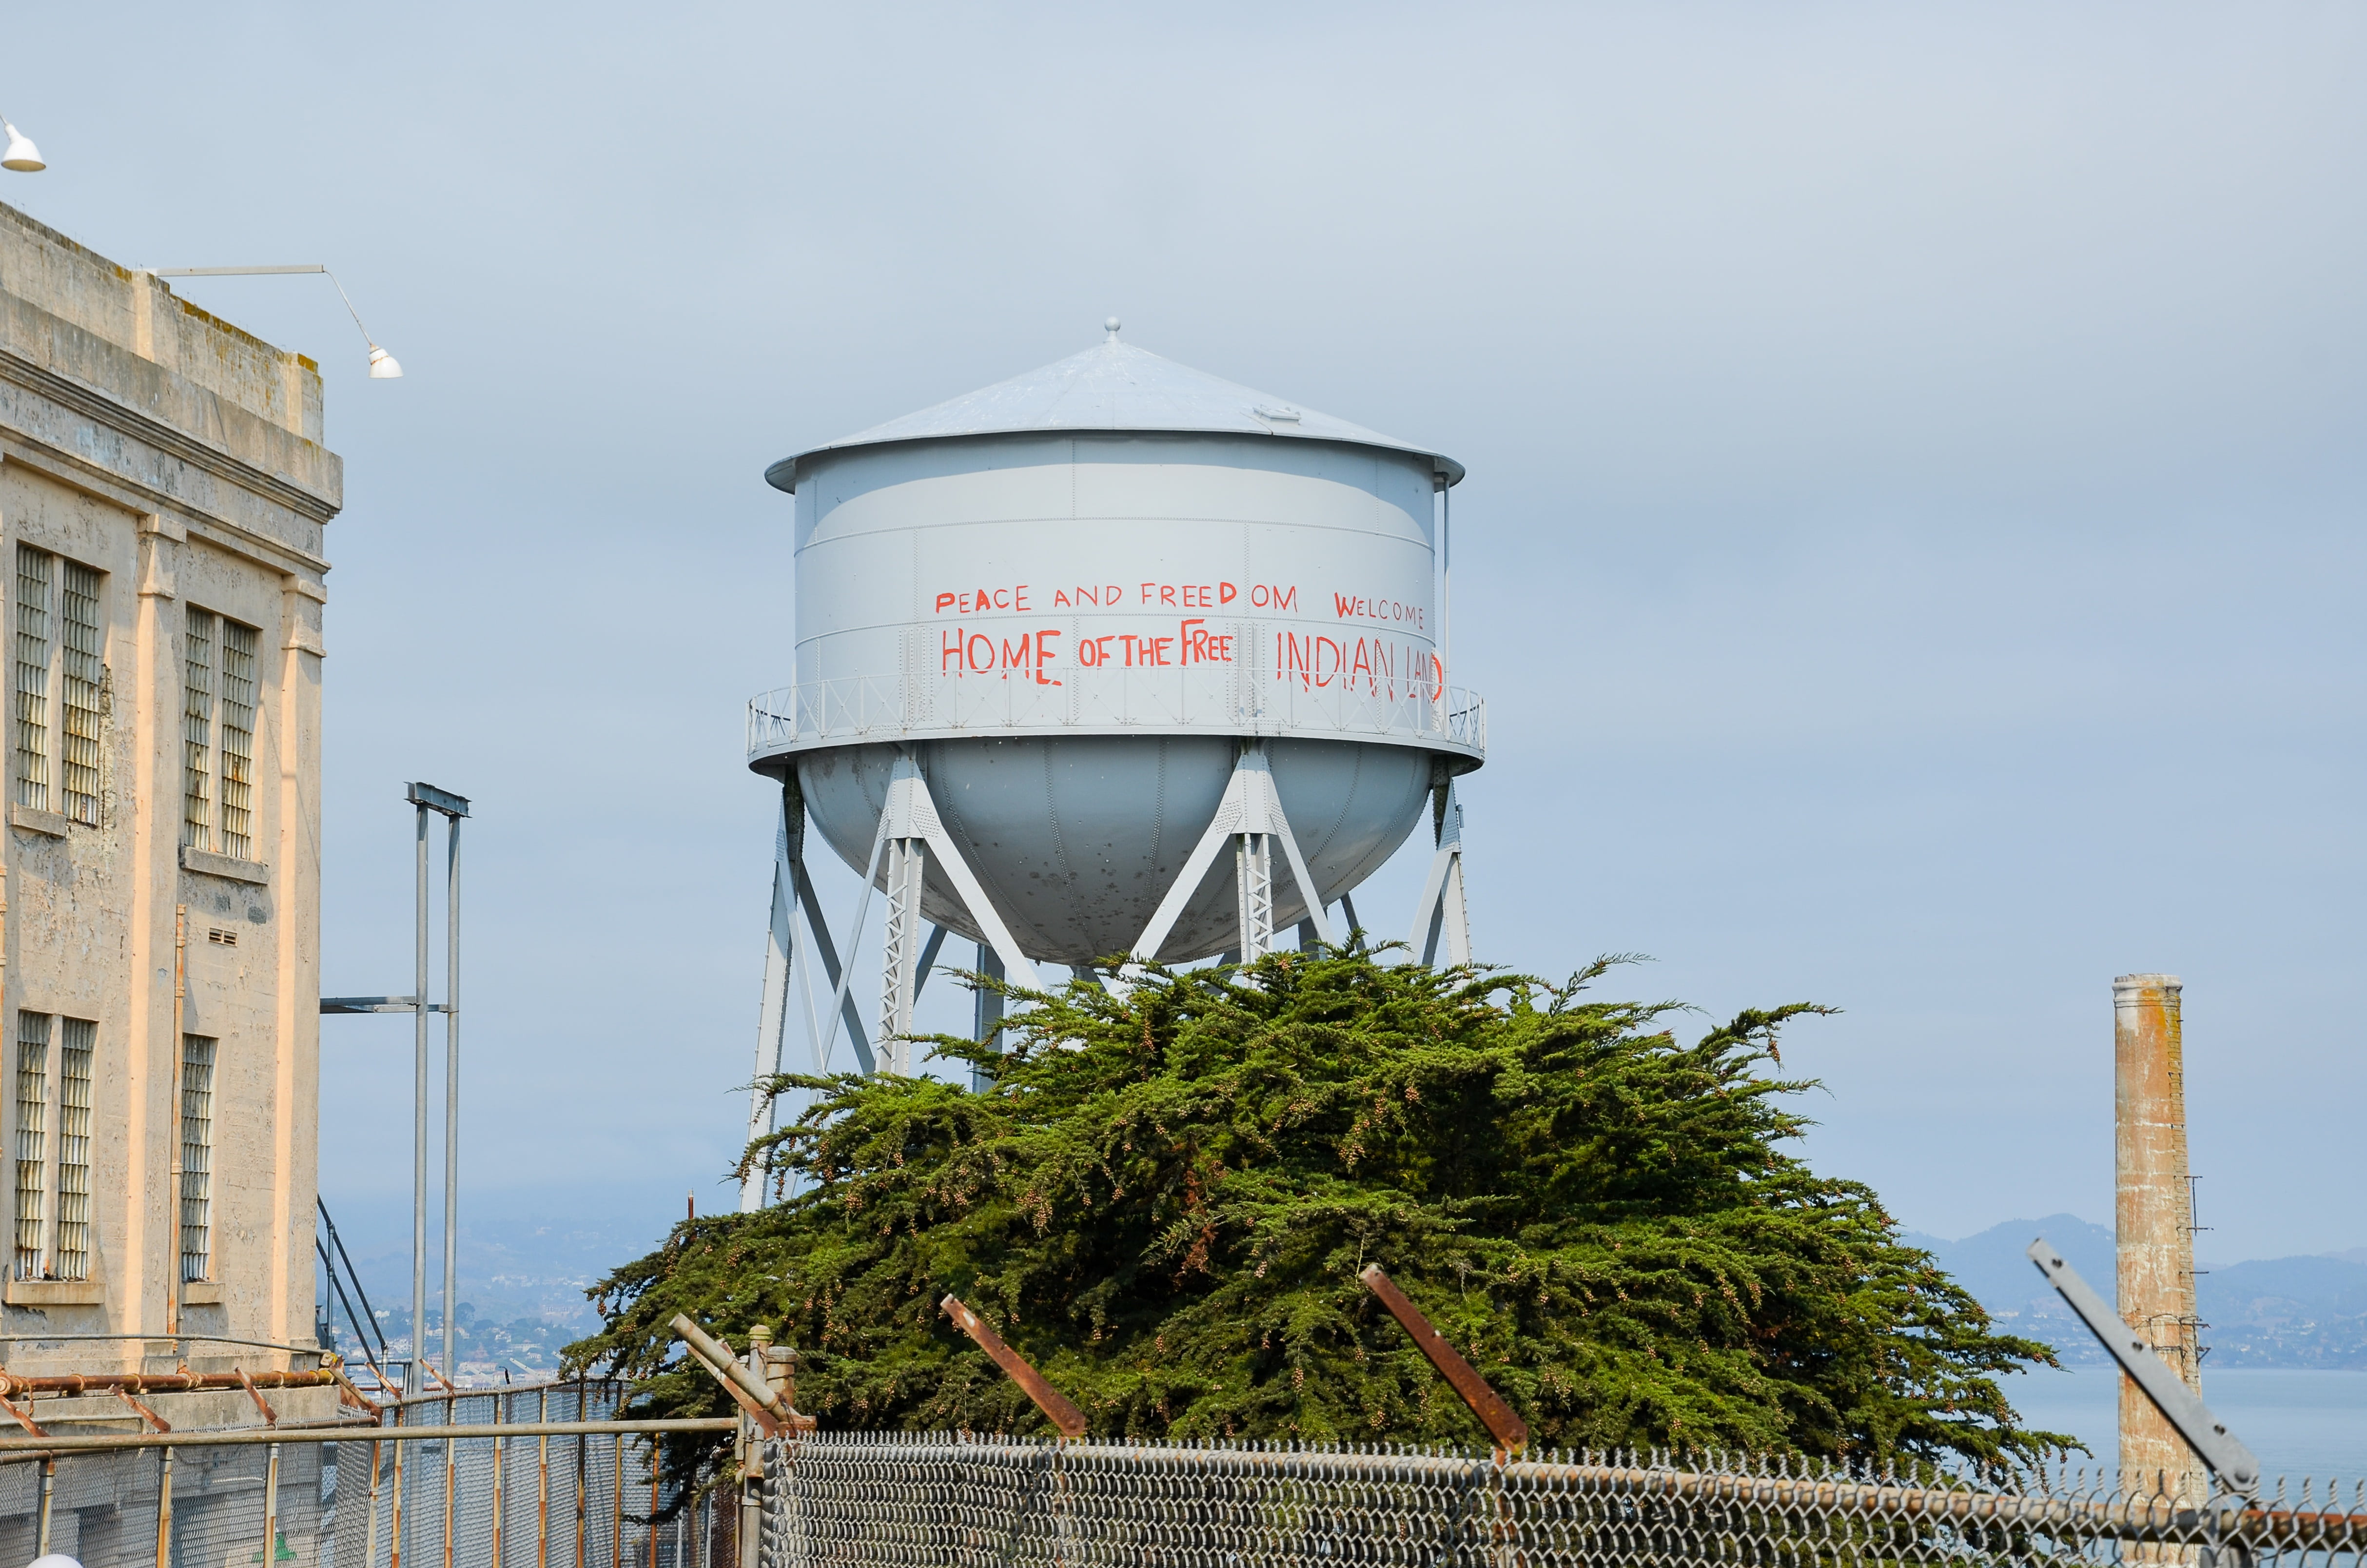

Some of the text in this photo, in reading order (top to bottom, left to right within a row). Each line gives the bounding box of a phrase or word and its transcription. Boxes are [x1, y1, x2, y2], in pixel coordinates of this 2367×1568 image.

[936, 585, 1032, 613] PEACE
[1054, 585, 1122, 607] AND
[1334, 592, 1423, 630] WELCOME
[942, 619, 1443, 705] HOME OF THE FREE INDIAN LAND
